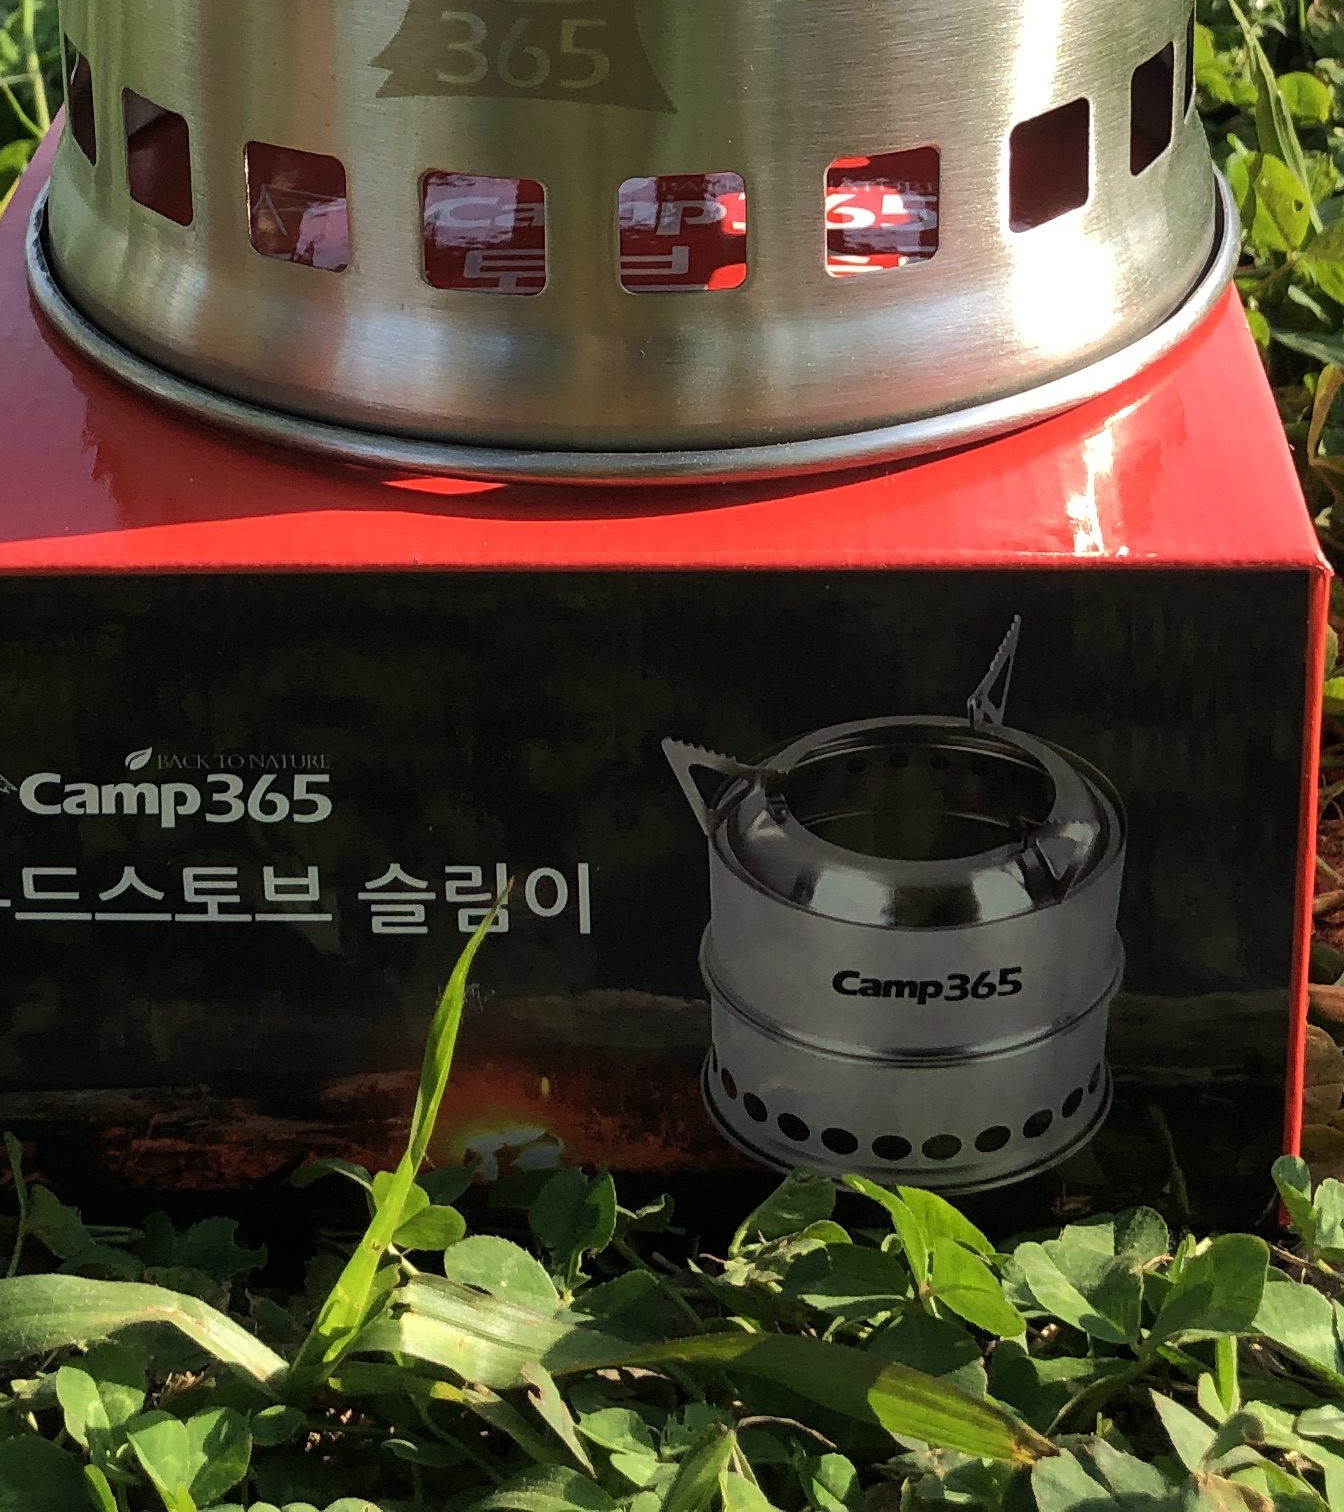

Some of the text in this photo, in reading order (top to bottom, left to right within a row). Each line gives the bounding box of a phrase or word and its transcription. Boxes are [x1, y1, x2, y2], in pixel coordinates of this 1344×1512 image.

[436, 11, 610, 88] 365
[157, 753, 332, 770] BACK TO NATURE
[19, 772, 333, 828] Camp365
[357, 861, 592, 935] 슬림이
[831, 966, 1023, 1006] Camp365
